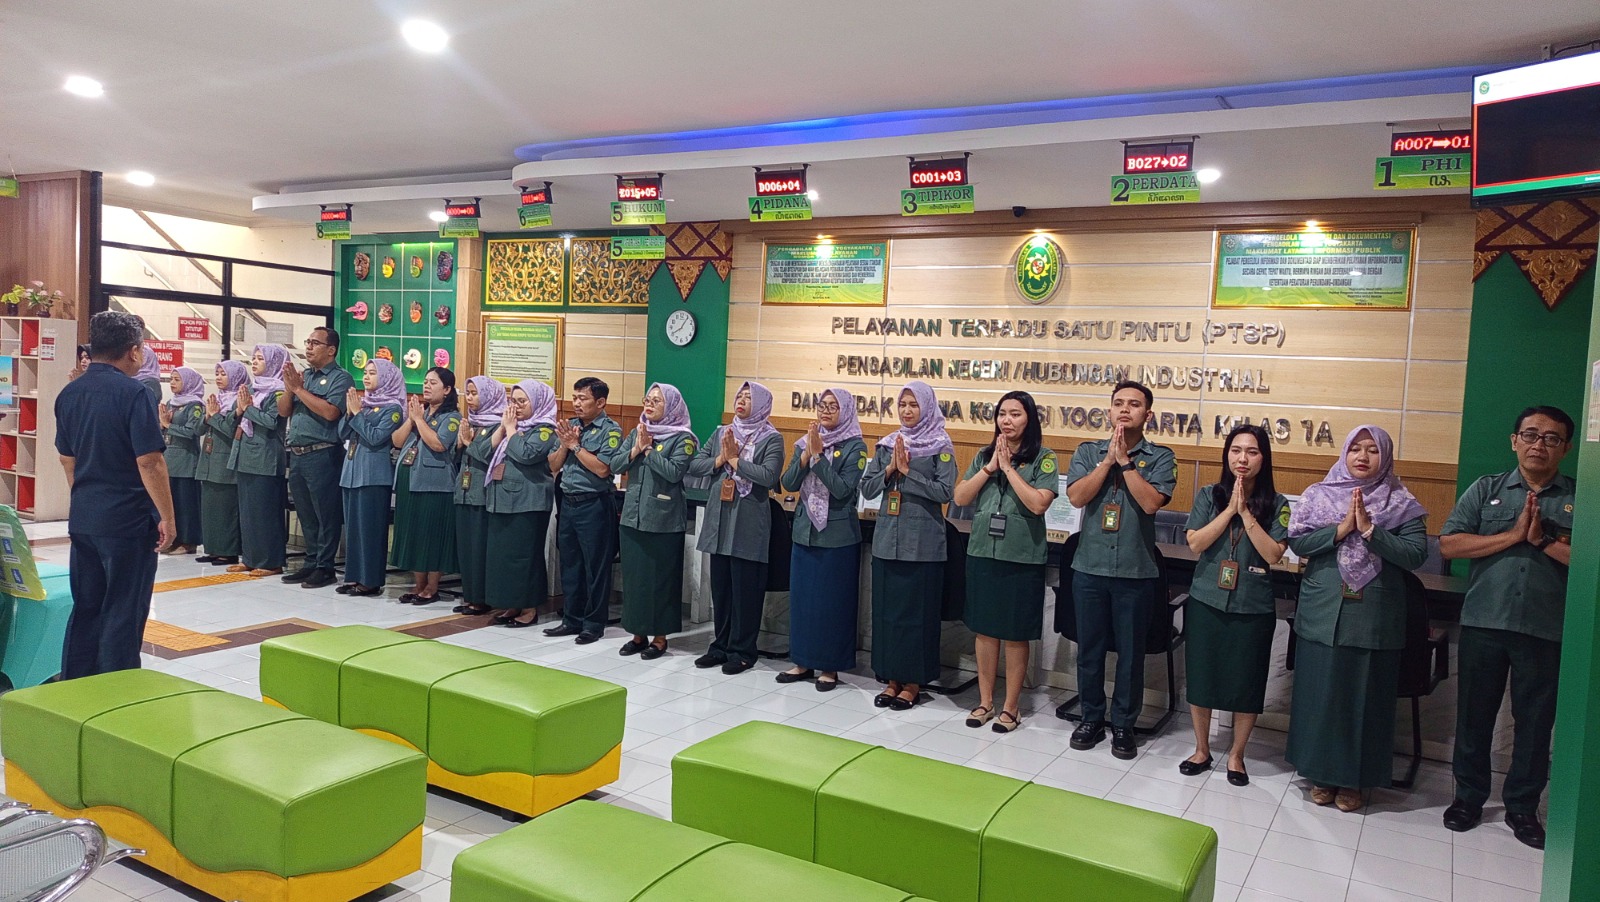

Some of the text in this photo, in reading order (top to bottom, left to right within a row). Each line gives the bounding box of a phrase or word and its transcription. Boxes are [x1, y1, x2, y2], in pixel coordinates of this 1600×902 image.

[1127, 155, 1187, 170] B027 02
[1379, 157, 1462, 187] 1 PHI
[1113, 178, 1130, 202] 2
[1132, 175, 1197, 190] PERDATA
[613, 205, 623, 222] 5
[624, 203, 662, 213] HUKUM
[751, 199, 763, 220] 4
[764, 197, 808, 209] PIDANA
[903, 192, 917, 214] 3
[919, 188, 971, 202] TIPIKOR
[520, 209, 526, 226] 6
[317, 224, 324, 239] 8
[612, 239, 623, 257] 5
[831, 316, 1286, 348] PELAYANAN TERPADU SATU PINTU (PTSP)
[837, 354, 942, 379] PENGADILAN
[948, 358, 1009, 380] NEGERI
[1136, 363, 1269, 393] INDUSTRIAL
[1300, 419, 1334, 444] 1A
